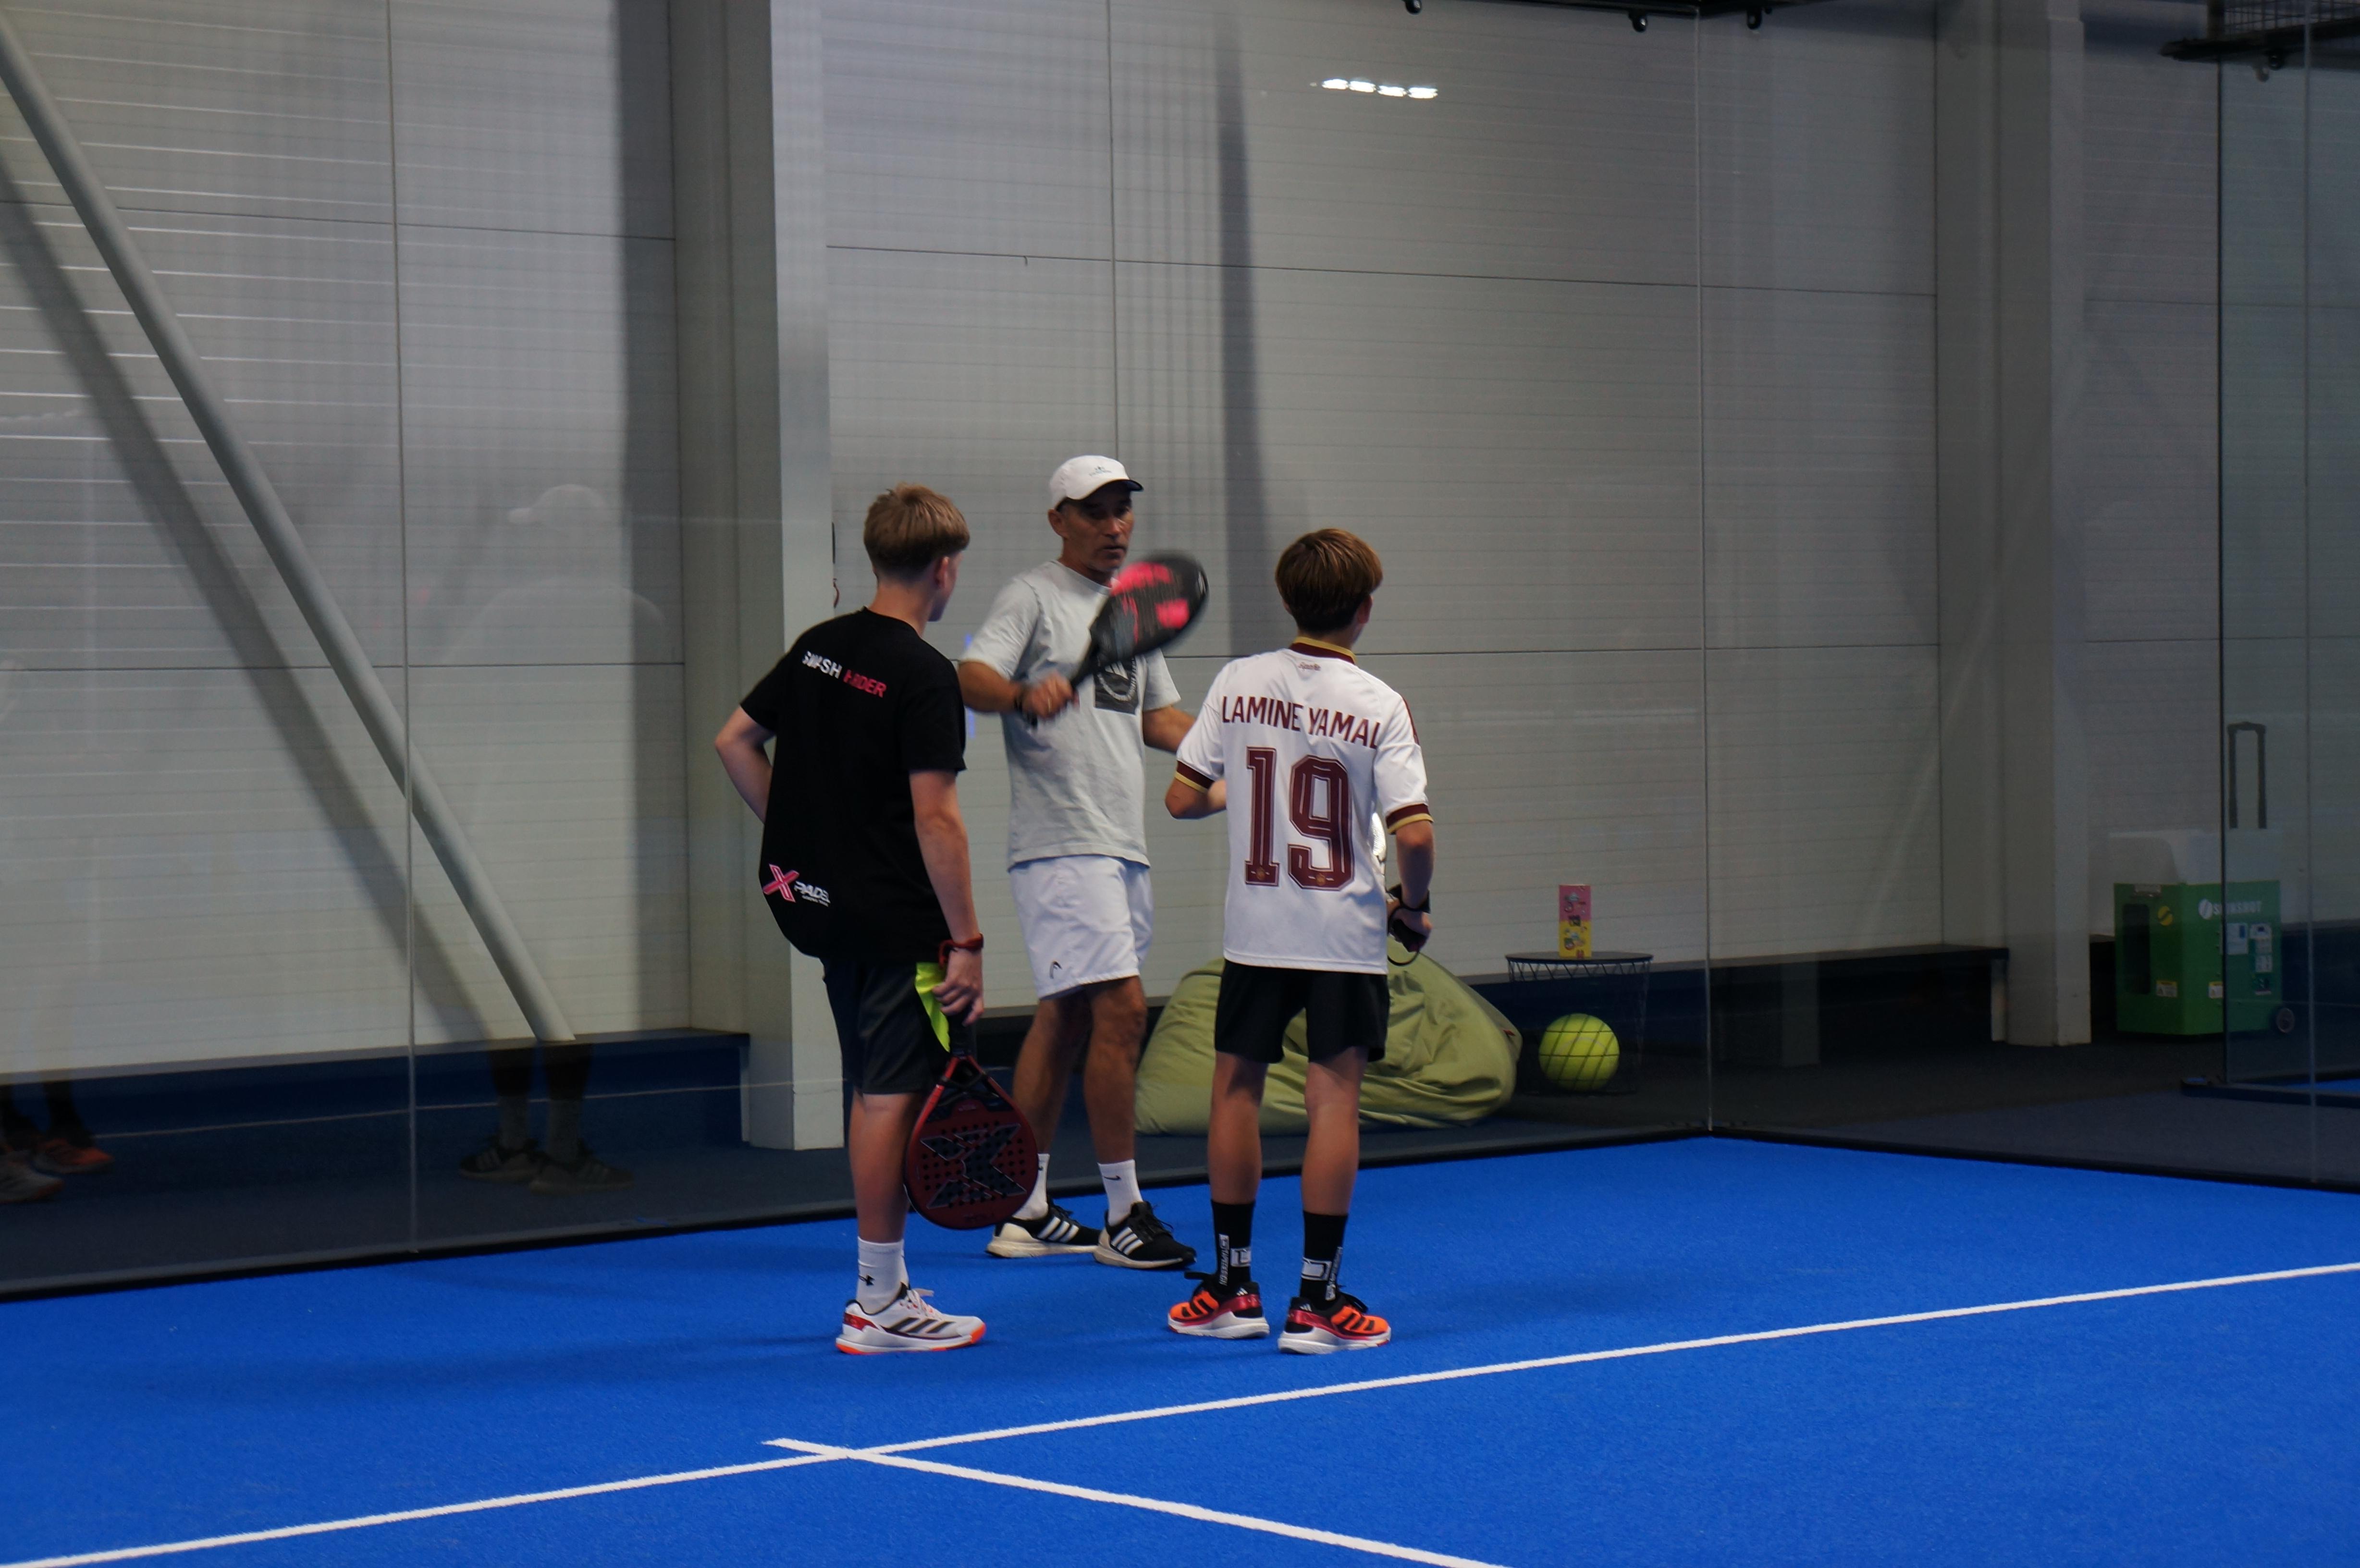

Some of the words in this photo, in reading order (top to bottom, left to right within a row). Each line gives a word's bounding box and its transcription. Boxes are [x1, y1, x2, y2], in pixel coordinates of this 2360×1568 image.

[1222, 695, 1304, 732] LAMINE
[1308, 707, 1381, 749] YAMAL
[1245, 746, 1354, 891] 19
